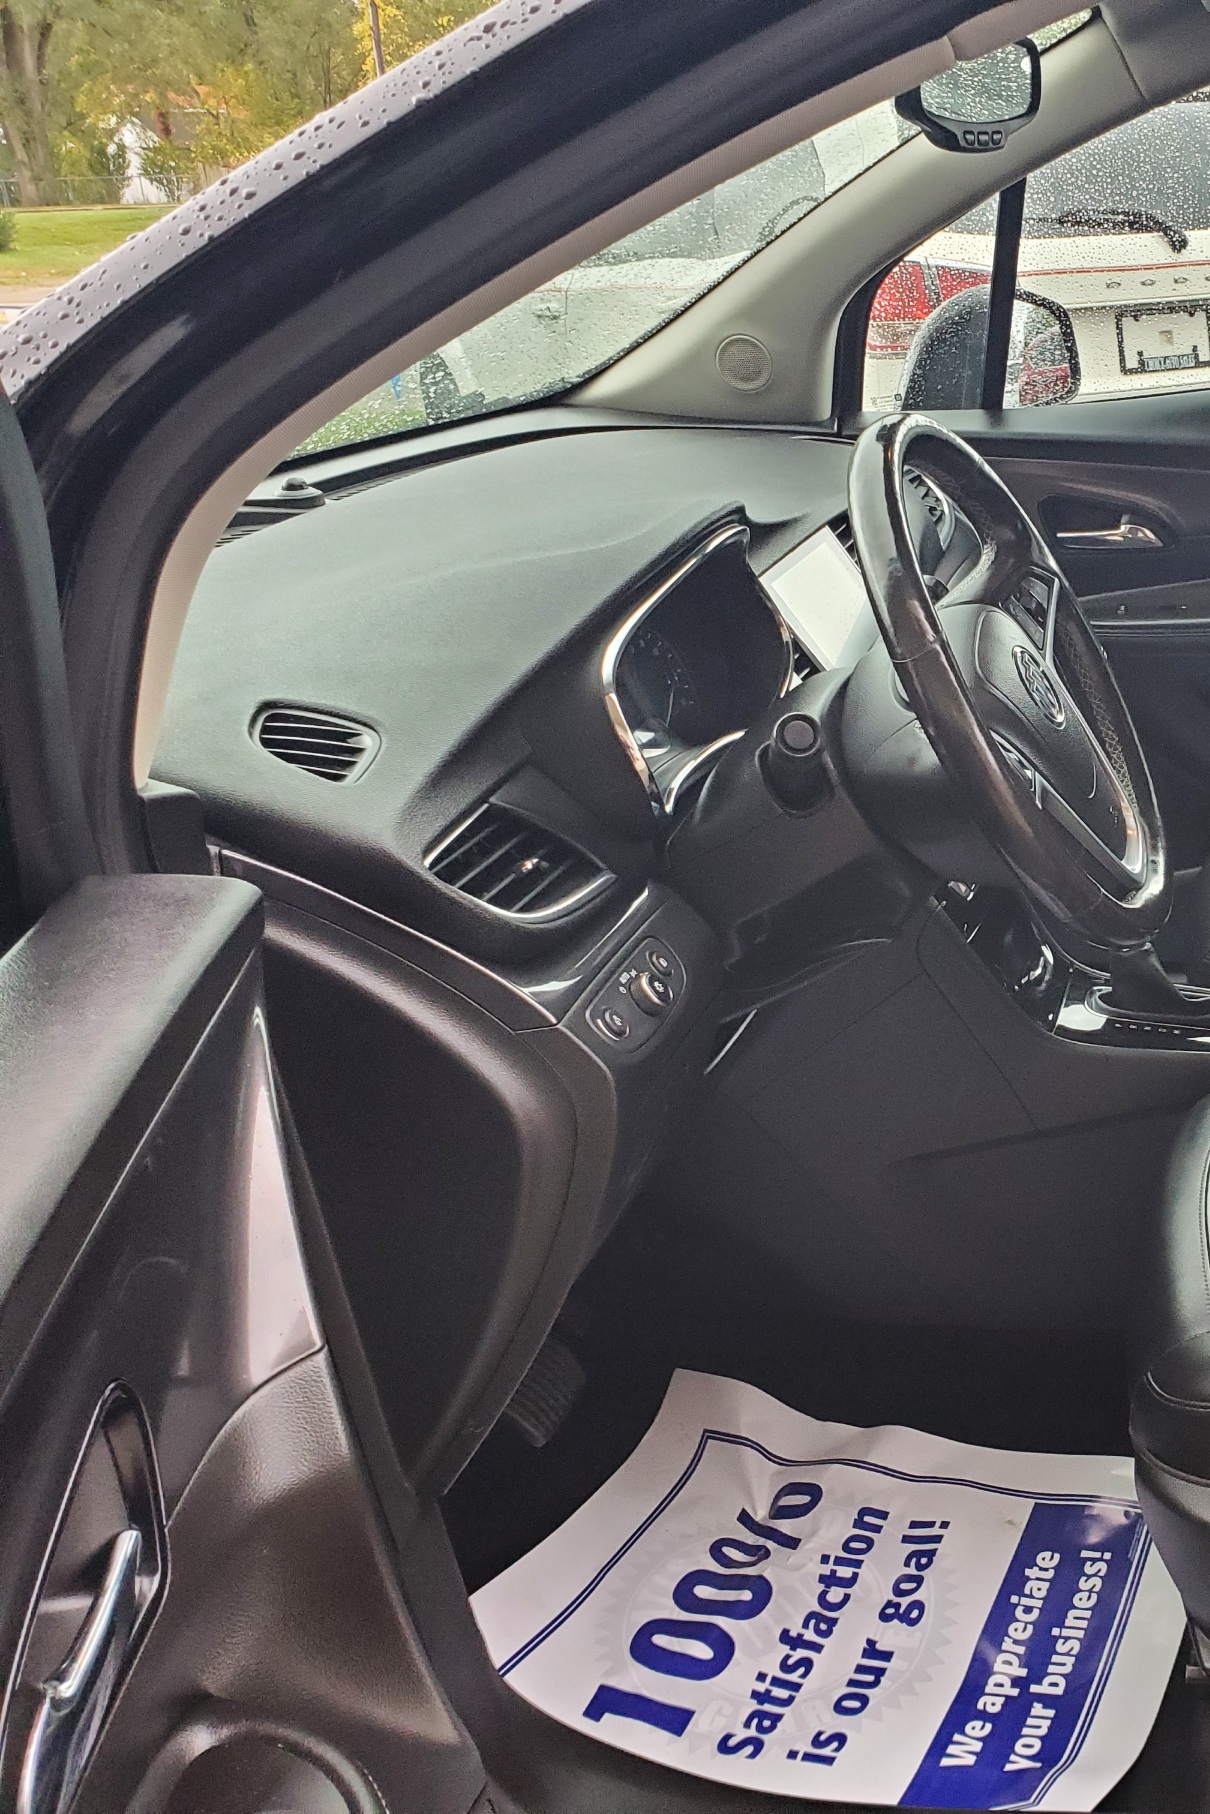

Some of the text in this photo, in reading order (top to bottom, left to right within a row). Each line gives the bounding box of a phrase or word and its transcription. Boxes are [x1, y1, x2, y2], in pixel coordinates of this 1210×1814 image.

[582, 1481, 824, 1738] 100%
[717, 1506, 890, 1760] Satisfaction
[786, 1730, 848, 1767] is
[834, 1638, 895, 1716] our
[878, 1519, 951, 1627] goal!
[939, 1551, 1061, 1768] We appreciate
[1003, 1548, 1112, 1773] your business!
